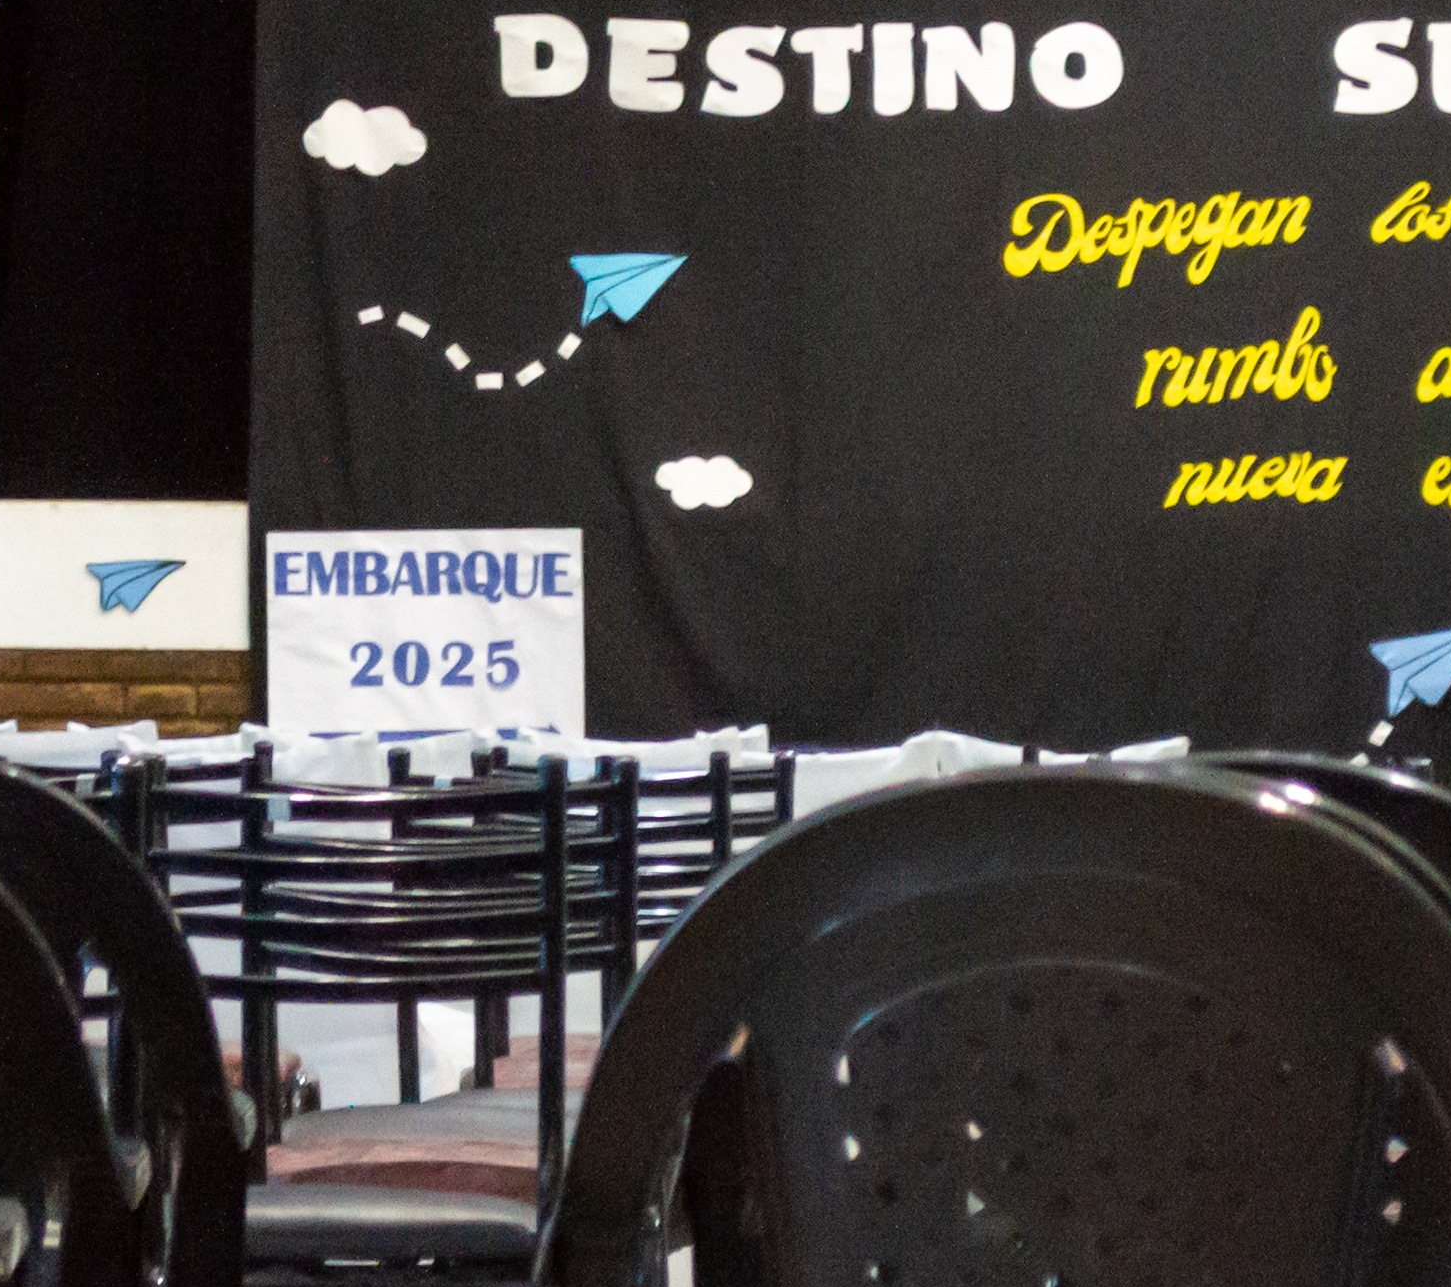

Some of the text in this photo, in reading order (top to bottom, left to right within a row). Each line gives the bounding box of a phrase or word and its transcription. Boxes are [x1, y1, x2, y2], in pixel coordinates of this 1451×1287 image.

[492, 12, 1126, 119] DESTINO
[1001, 189, 1313, 290] Despegan
[1134, 304, 1339, 410] rumbo
[1162, 450, 1349, 510] nueva
[272, 549, 575, 604] EMBARQUE
[349, 639, 522, 692] 2025
